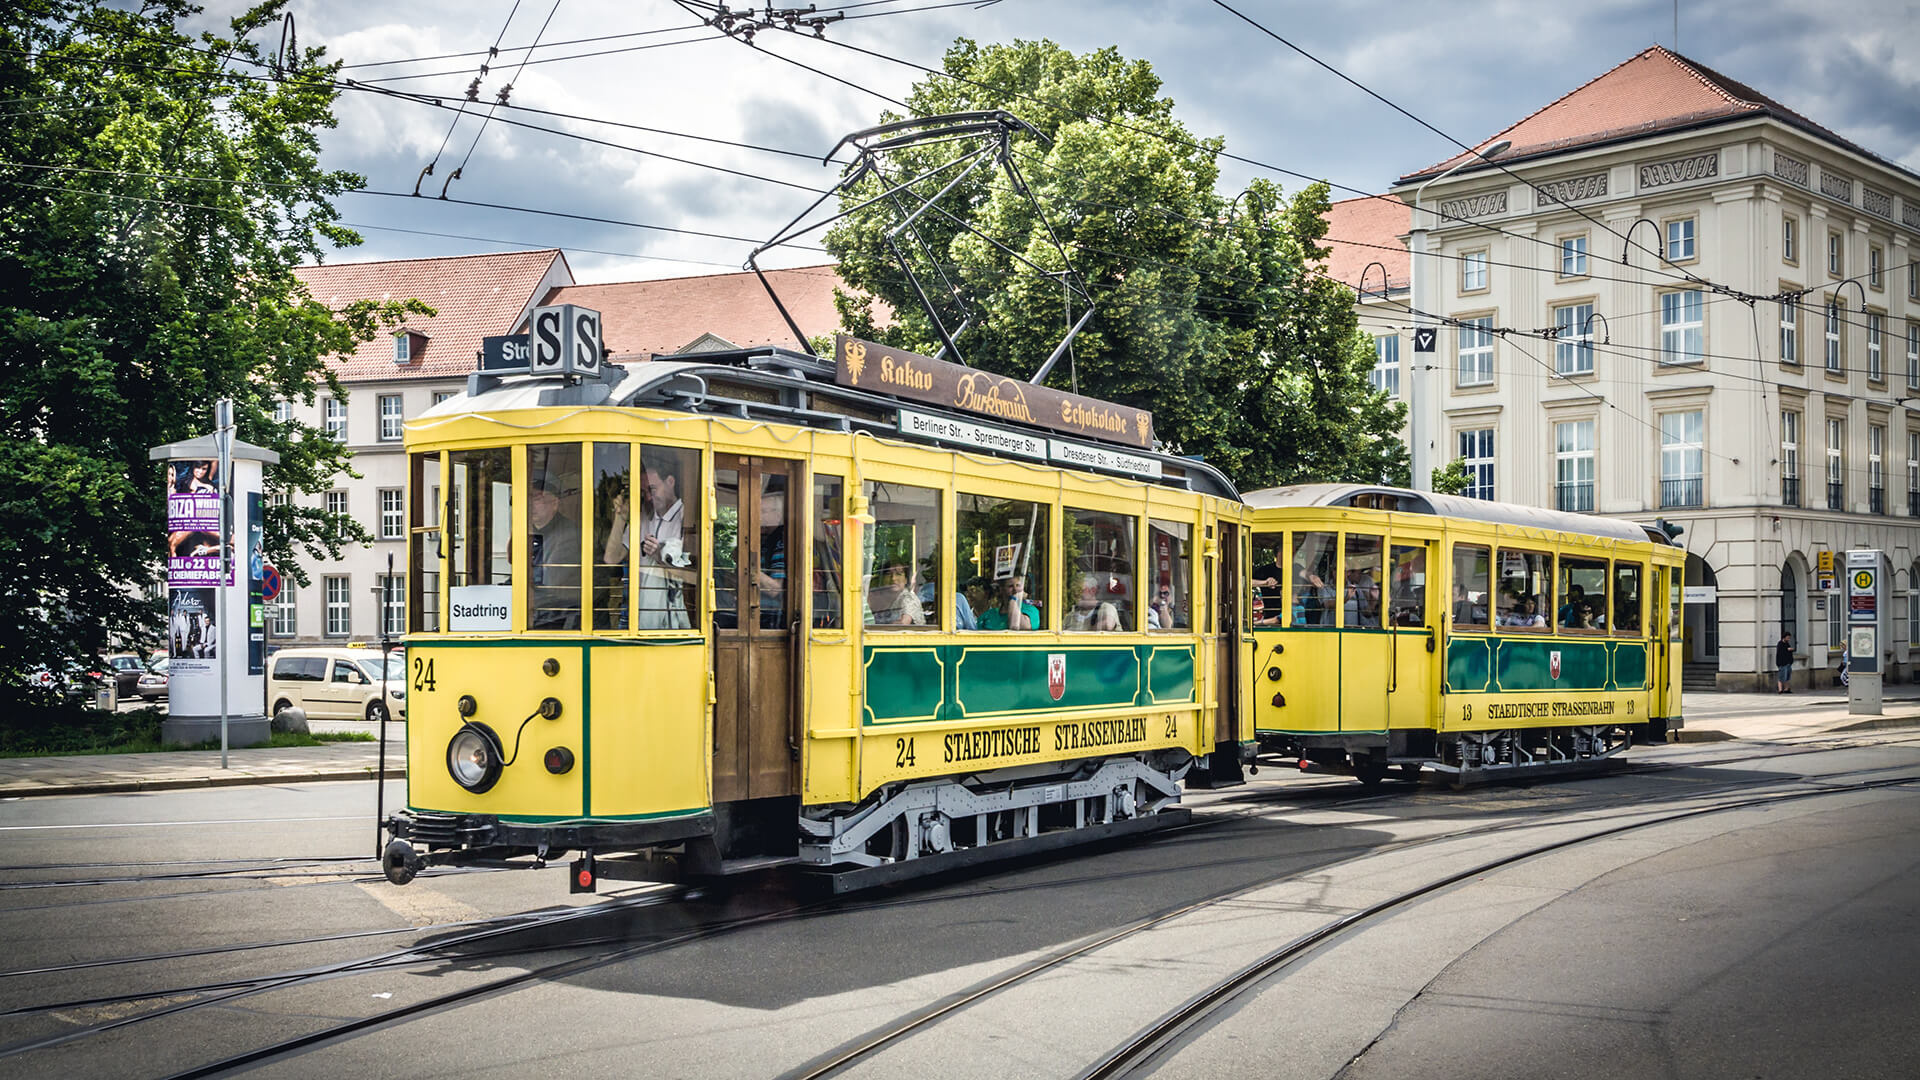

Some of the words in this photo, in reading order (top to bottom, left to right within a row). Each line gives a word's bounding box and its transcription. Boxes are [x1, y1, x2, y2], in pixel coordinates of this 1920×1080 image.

[537, 312, 561, 366] S
[577, 314, 598, 369] S
[880, 355, 933, 391] Kakao
[1061, 399, 1128, 434] Schokolade
[913, 416, 947, 432] Berliner
[948, 423, 964, 439] Str.
[974, 428, 1024, 453] Spremberger
[1024, 440, 1038, 453] Str.
[1063, 446, 1097, 463] Dresdener
[1097, 452, 1109, 465] Str.
[1116, 457, 1151, 473] Südfriedhof
[192, 559, 205, 569] 22
[453, 603, 508, 620] Stadtring
[414, 656, 437, 692] 24
[1462, 704, 1472, 721] 13
[1488, 702, 1549, 720] STAEDTISCHE
[1552, 700, 1615, 717] STRASSENBAHN
[1626, 700, 1635, 715] 13
[895, 737, 916, 768] 24
[943, 727, 1041, 763] STAEDTISCHE
[1054, 717, 1147, 751] STRASSENBAHN
[1165, 715, 1178, 739] 24
